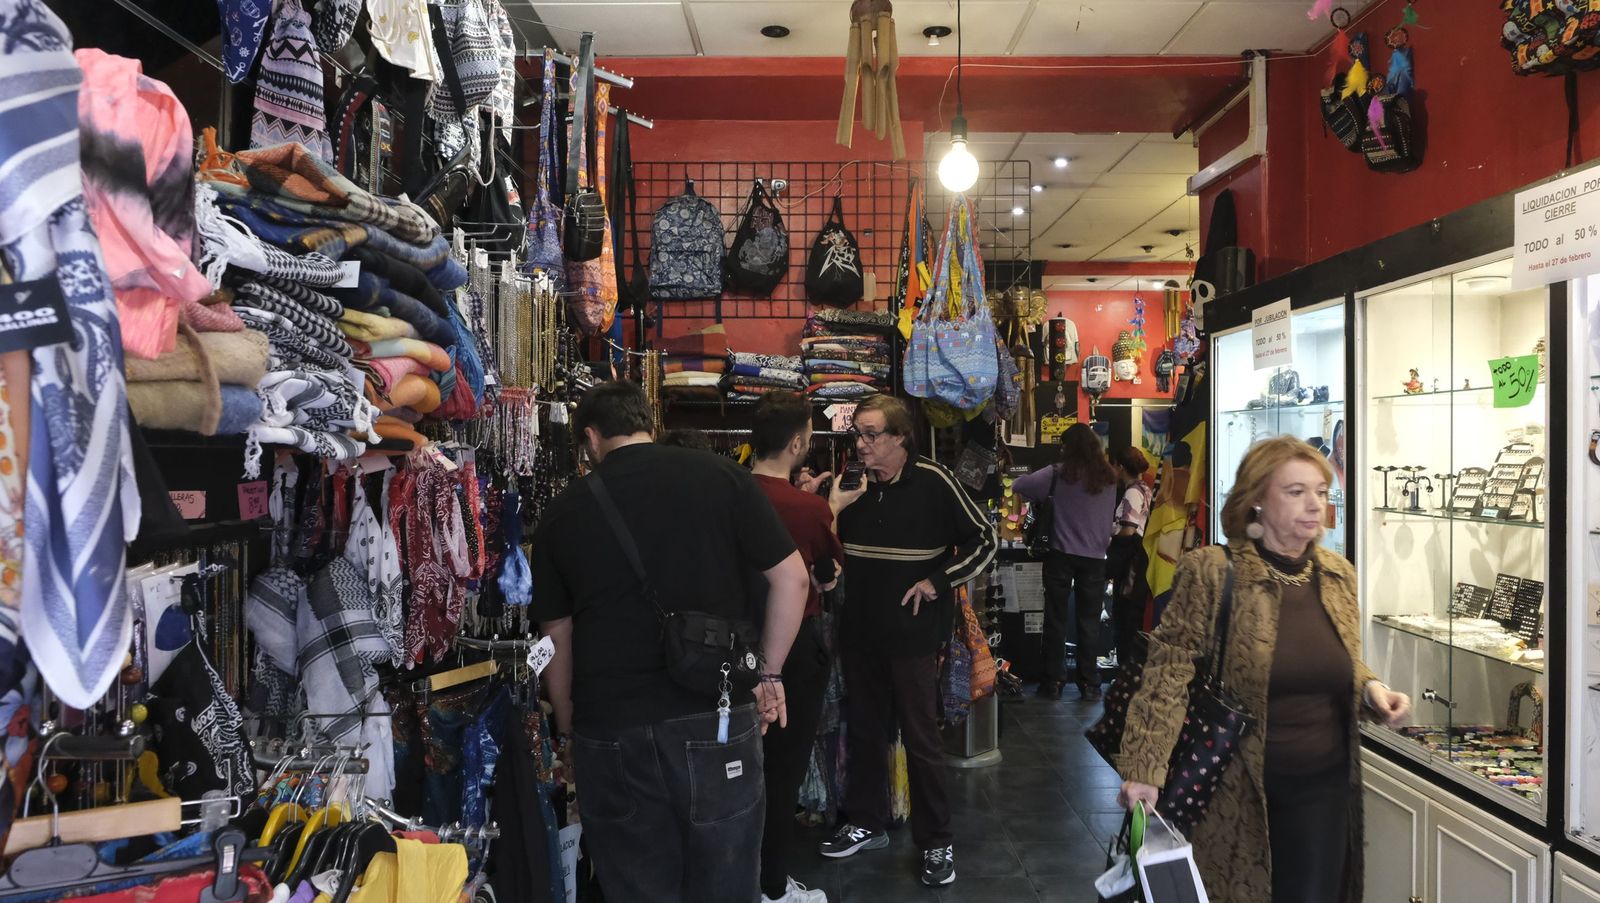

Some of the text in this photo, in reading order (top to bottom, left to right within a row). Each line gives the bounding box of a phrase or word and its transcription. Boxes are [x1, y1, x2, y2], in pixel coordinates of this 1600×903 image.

[1522, 186, 1577, 212] LIQUIDACION
[1544, 201, 1576, 220] CIERRE
[1524, 238, 1549, 254] TODO
[1556, 233, 1564, 246] al
[1574, 228, 1586, 241] 50
[1528, 251, 1592, 271] Hasta el 27 de febrero
[1254, 317, 1263, 325] POR
[1255, 337, 1266, 346] TODO
[1508, 366, 1535, 399] 50%
